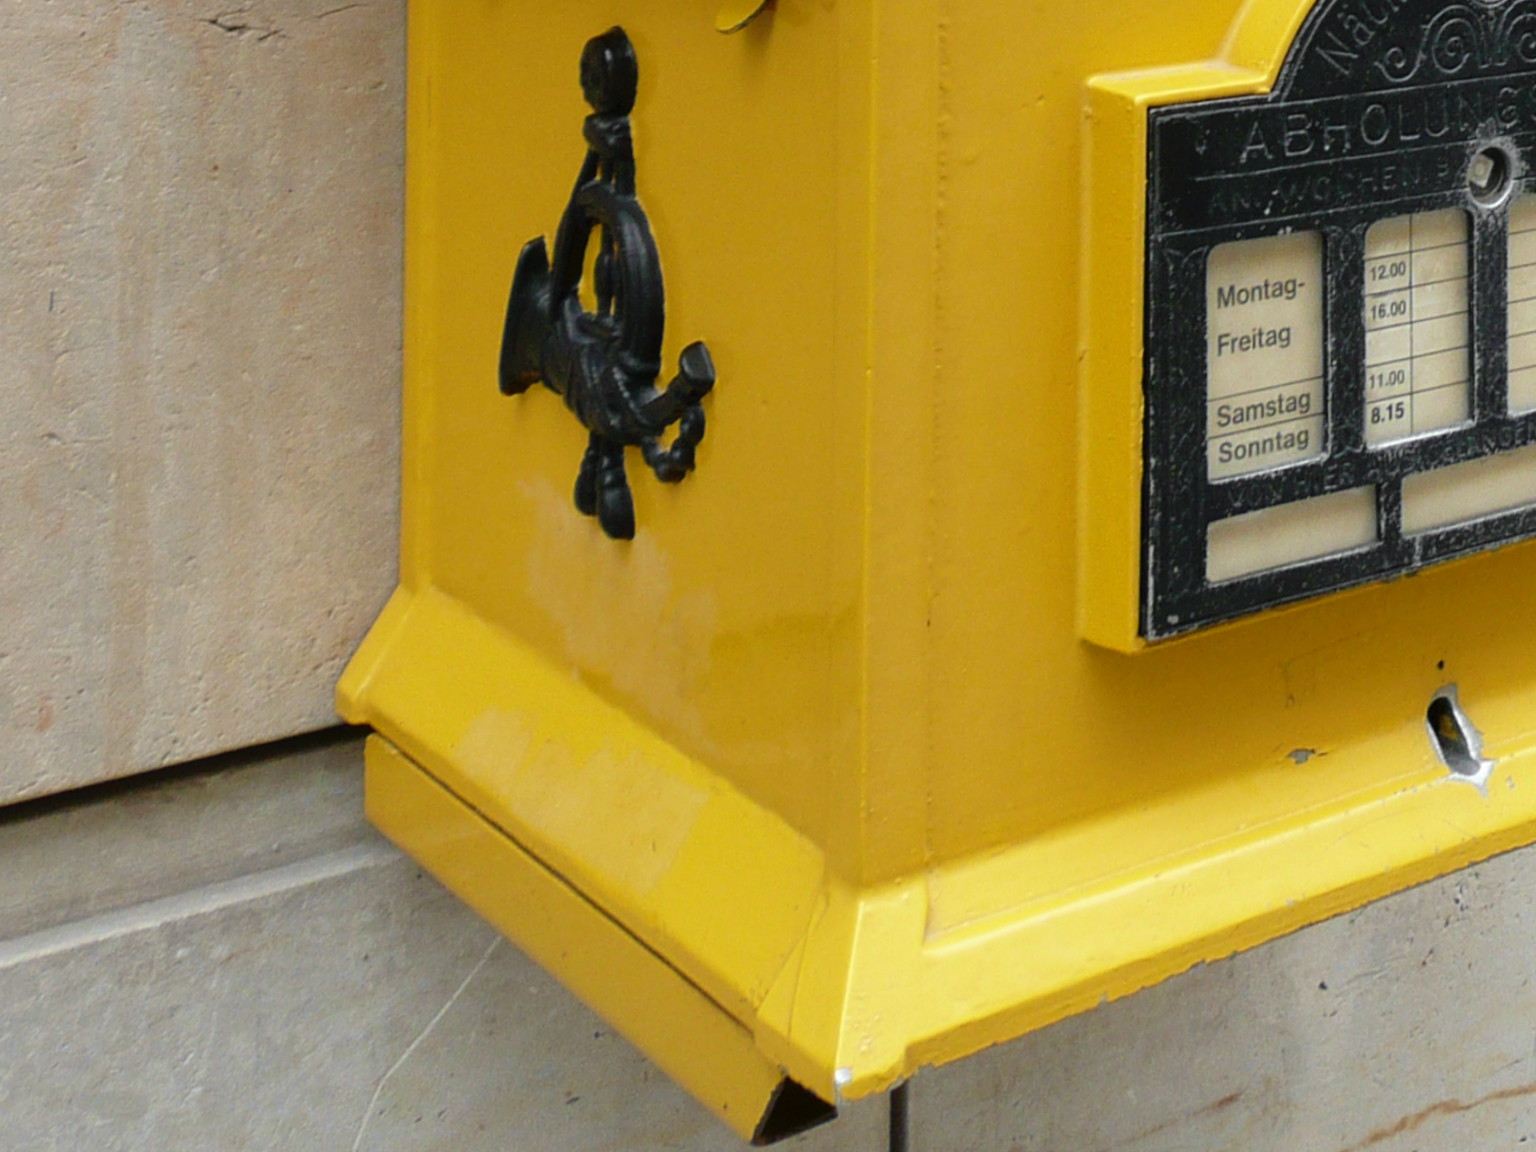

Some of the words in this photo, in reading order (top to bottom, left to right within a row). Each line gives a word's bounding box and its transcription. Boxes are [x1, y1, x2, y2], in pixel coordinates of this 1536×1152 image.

[1370, 260, 1408, 281] 12.00
[1216, 278, 1306, 309] Montag-
[1370, 299, 1408, 320] 16.00
[1217, 327, 1292, 357] Freitag
[1369, 369, 1406, 389] 11.00
[1217, 392, 1311, 428] Samstag
[1370, 401, 1405, 425] 8.15
[1218, 429, 1310, 463] Sonntag
